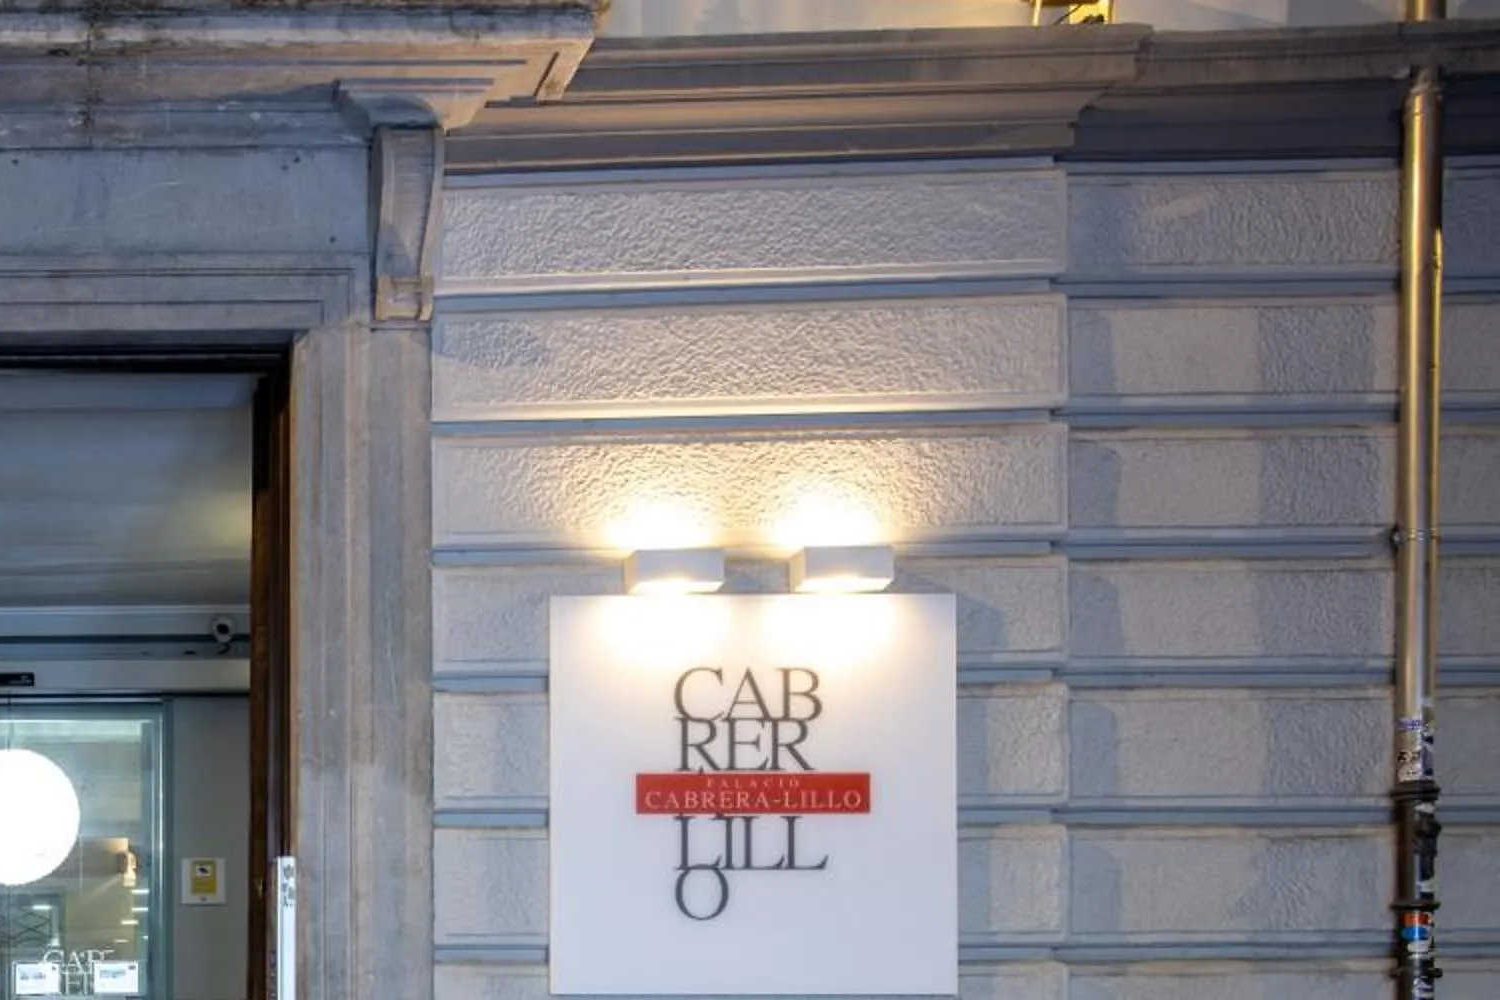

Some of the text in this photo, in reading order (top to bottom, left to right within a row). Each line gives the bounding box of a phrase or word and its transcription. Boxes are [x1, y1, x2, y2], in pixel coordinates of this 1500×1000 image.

[673, 667, 823, 722] CAB
[673, 716, 816, 772] RER
[644, 789, 862, 810] CABRERA-LILLO
[706, 777, 800, 789] PALACIO
